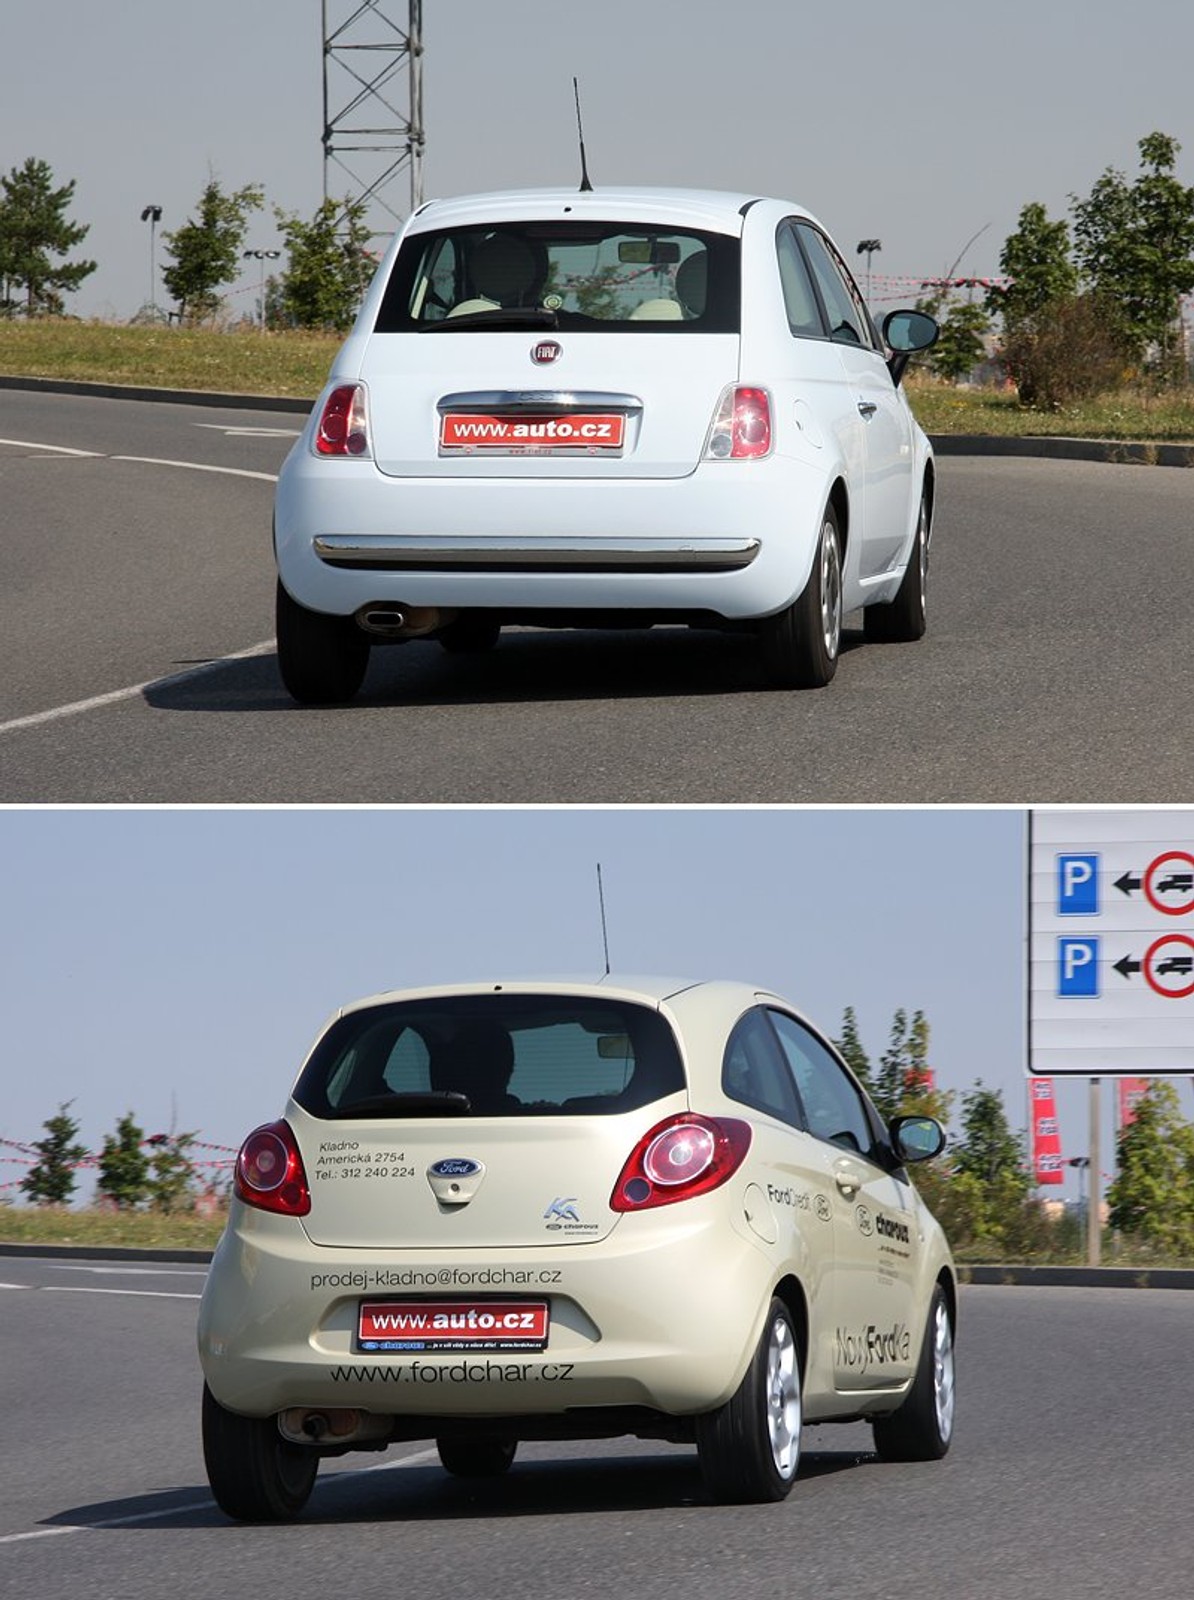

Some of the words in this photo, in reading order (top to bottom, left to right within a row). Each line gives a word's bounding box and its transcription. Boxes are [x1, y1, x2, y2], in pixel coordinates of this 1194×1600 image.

[537, 346, 557, 358] FIAT
[454, 420, 611, 438] www.auto.cz
[1064, 861, 1092, 897] P
[1064, 943, 1092, 979] P
[319, 1141, 359, 1152] Kladno
[317, 1153, 371, 1165] Americká
[375, 1153, 405, 1162] 2754
[439, 1161, 469, 1174] Ford
[315, 1169, 337, 1180] Tel.:
[341, 1168, 360, 1178] 312
[365, 1167, 387, 1177] 240
[391, 1167, 415, 1177] 224
[311, 1269, 562, 1290] prodej-kladno@fordchar.cz
[372, 1309, 534, 1329] www.auto.cz
[330, 1360, 574, 1384] www.fordchar.cz
